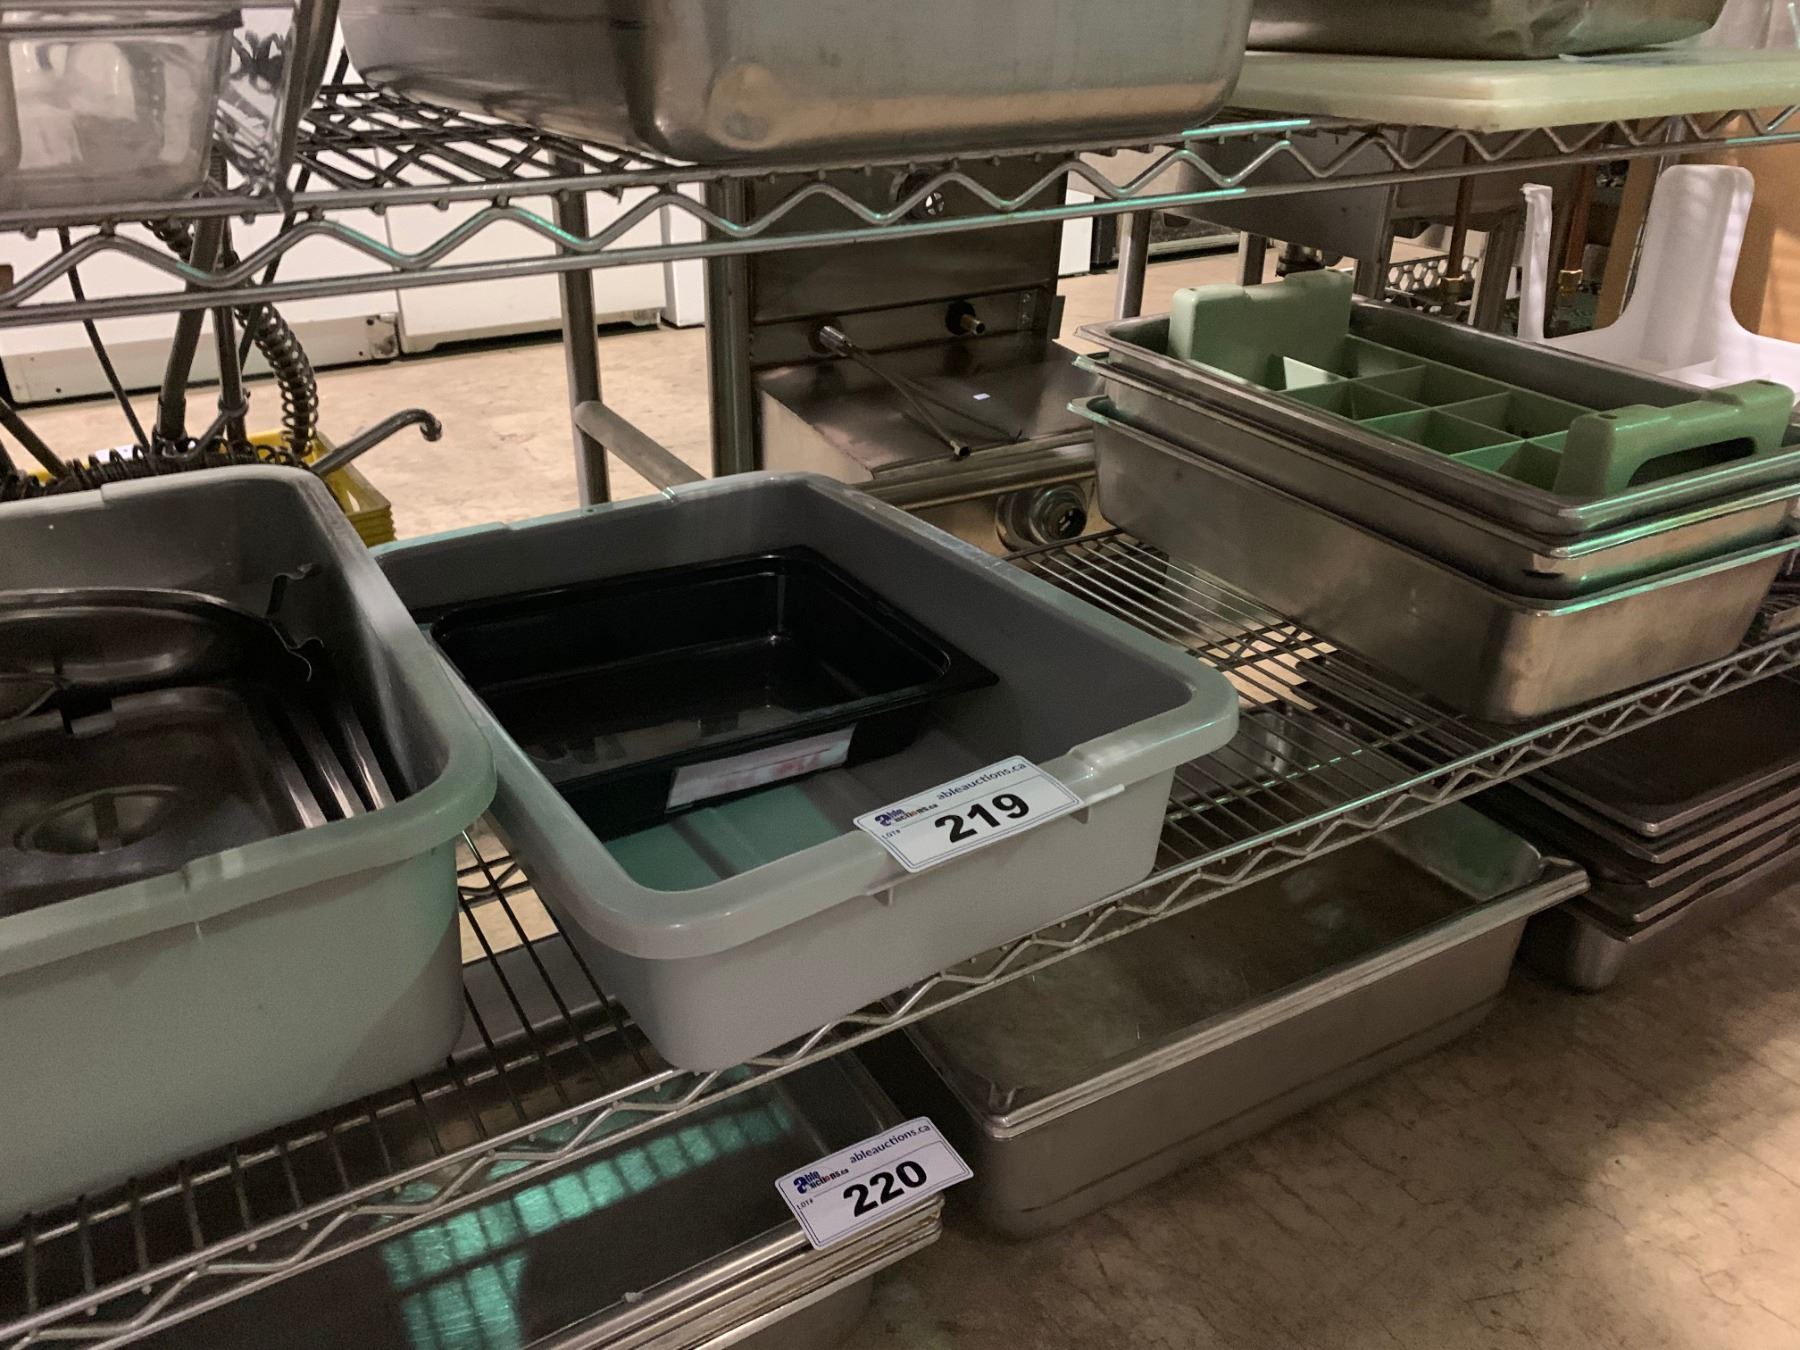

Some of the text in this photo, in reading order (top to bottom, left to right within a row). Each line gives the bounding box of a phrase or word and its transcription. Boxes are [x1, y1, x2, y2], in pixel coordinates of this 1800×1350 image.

[936, 762, 1027, 800] ableauctions.ca
[935, 793, 1030, 843] 219
[849, 1124, 931, 1164] ableauctions.ca
[843, 1160, 927, 1217] 220
